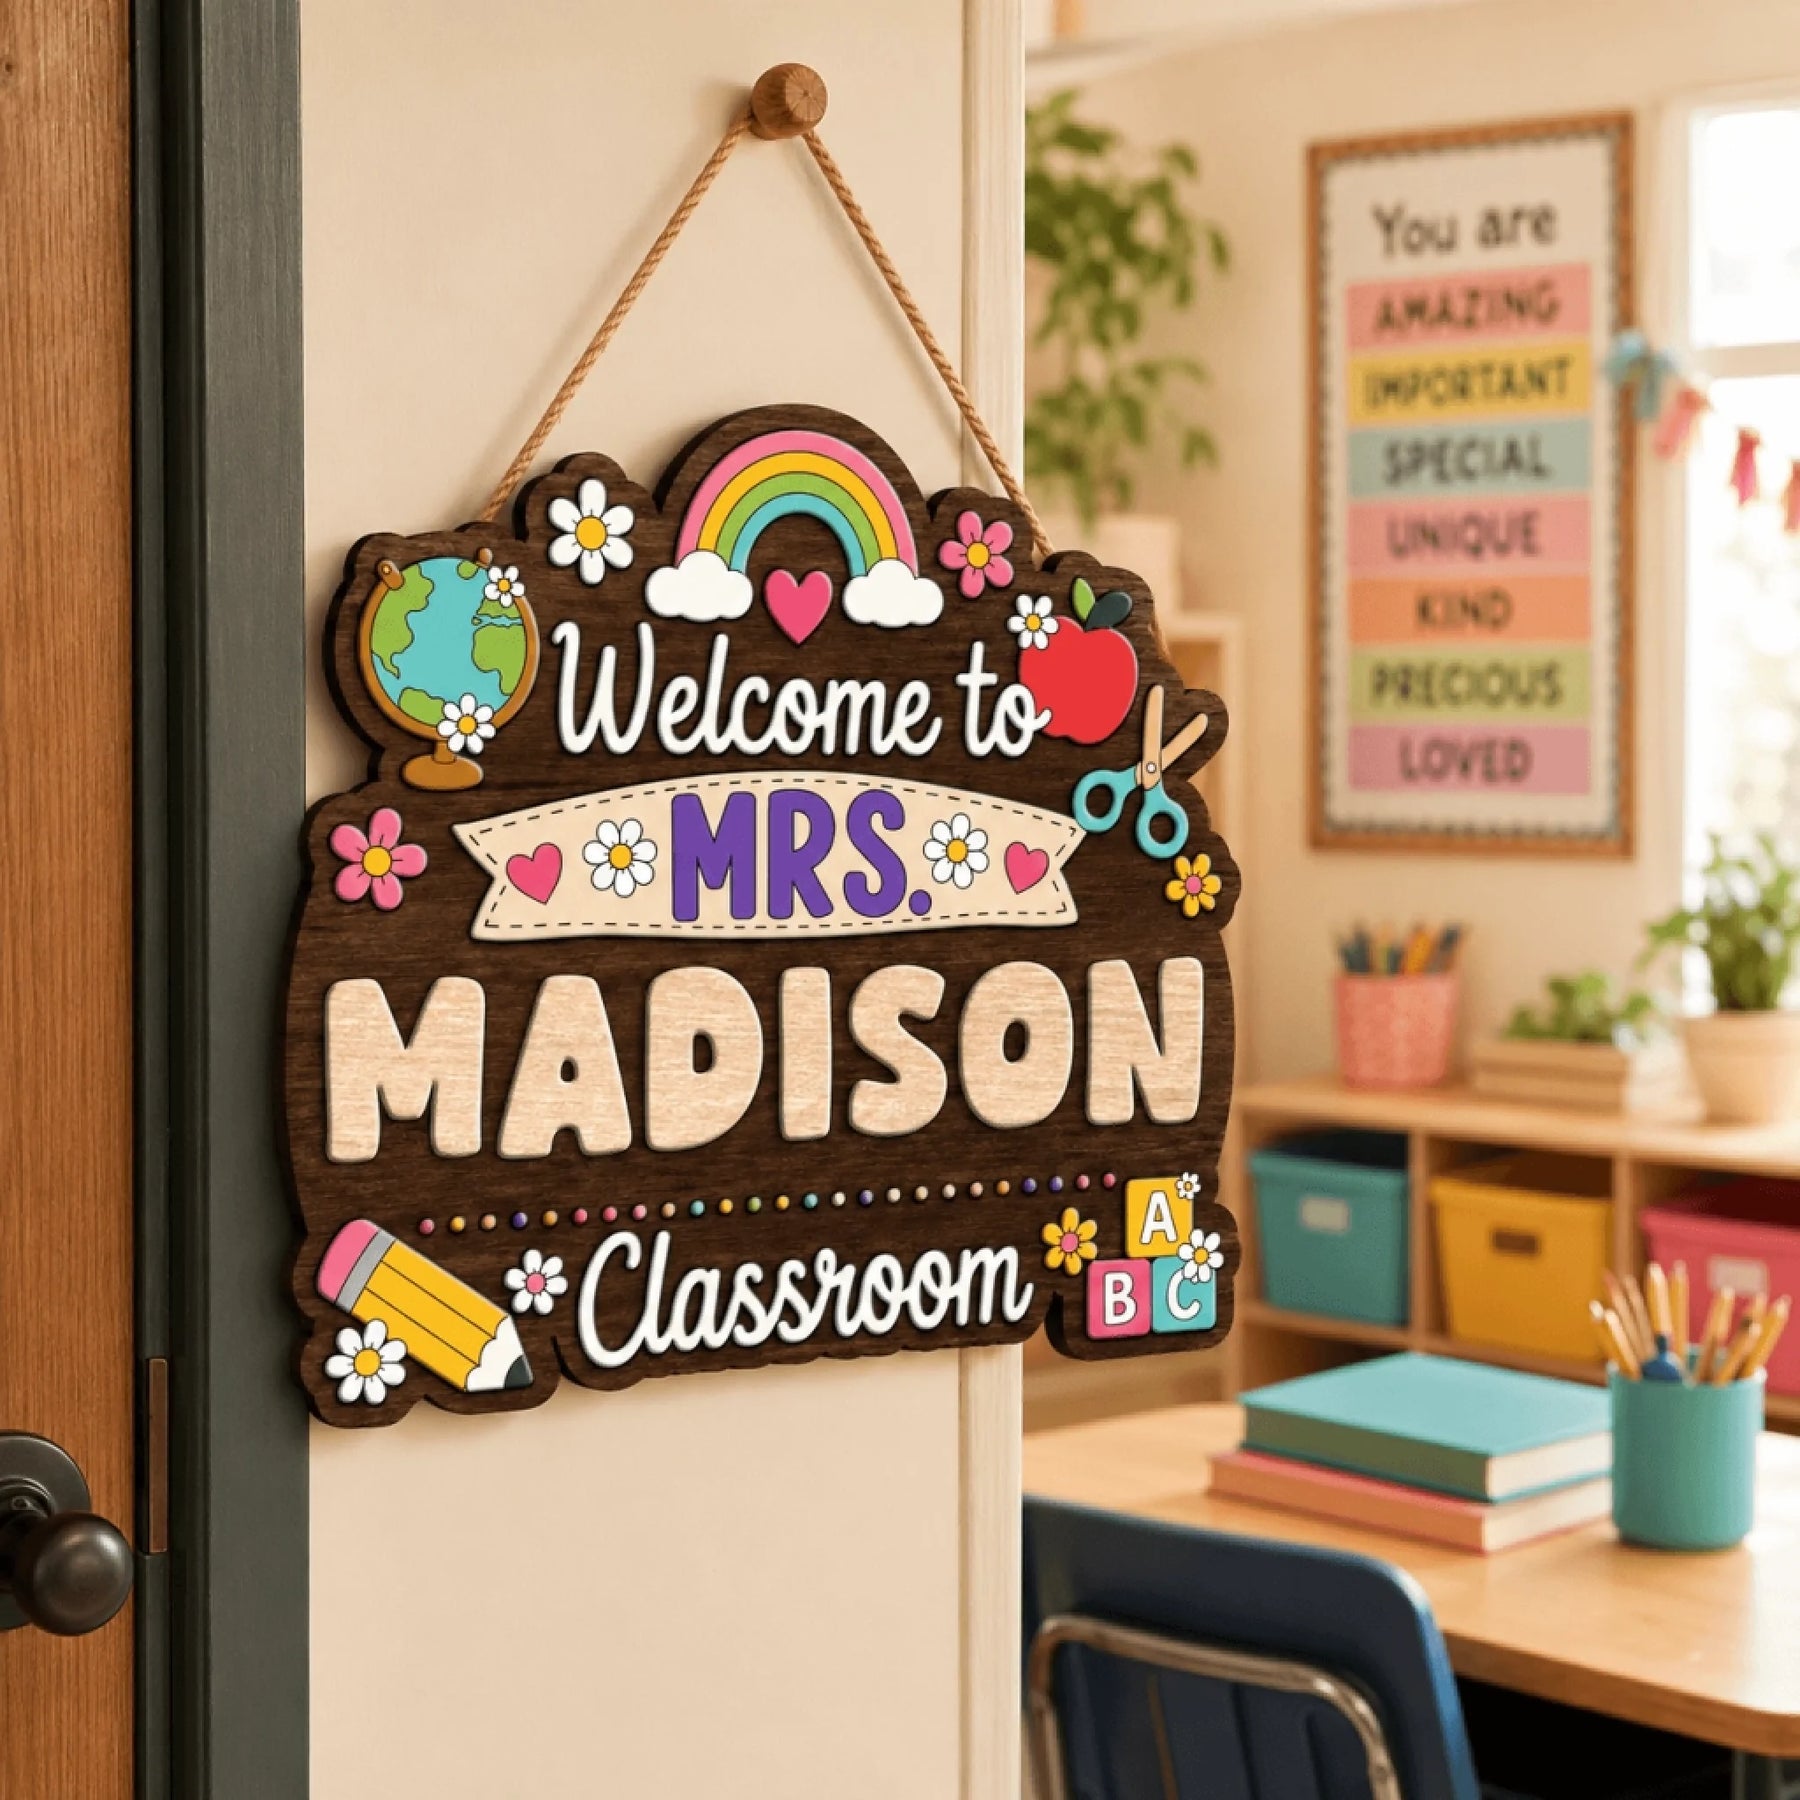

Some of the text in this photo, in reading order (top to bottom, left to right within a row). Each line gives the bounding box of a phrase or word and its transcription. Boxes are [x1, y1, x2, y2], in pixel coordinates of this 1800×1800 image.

[1372, 201, 1558, 256] You are
[1374, 280, 1560, 334] AMAZING
[1364, 353, 1573, 411] IMPORTANT
[1384, 432, 1551, 486] SPECIAL
[1385, 508, 1541, 560] UNIQUE
[1414, 587, 1514, 633] KIND
[551, 621, 1053, 758] Welcome to
[1371, 658, 1563, 708] PRECIOUS
[1400, 736, 1534, 783] LOVED
[670, 788, 932, 923] MRS.
[325, 956, 1205, 1164] MADISON
[1139, 1190, 1178, 1244] A
[577, 1230, 1034, 1369] Classroom
